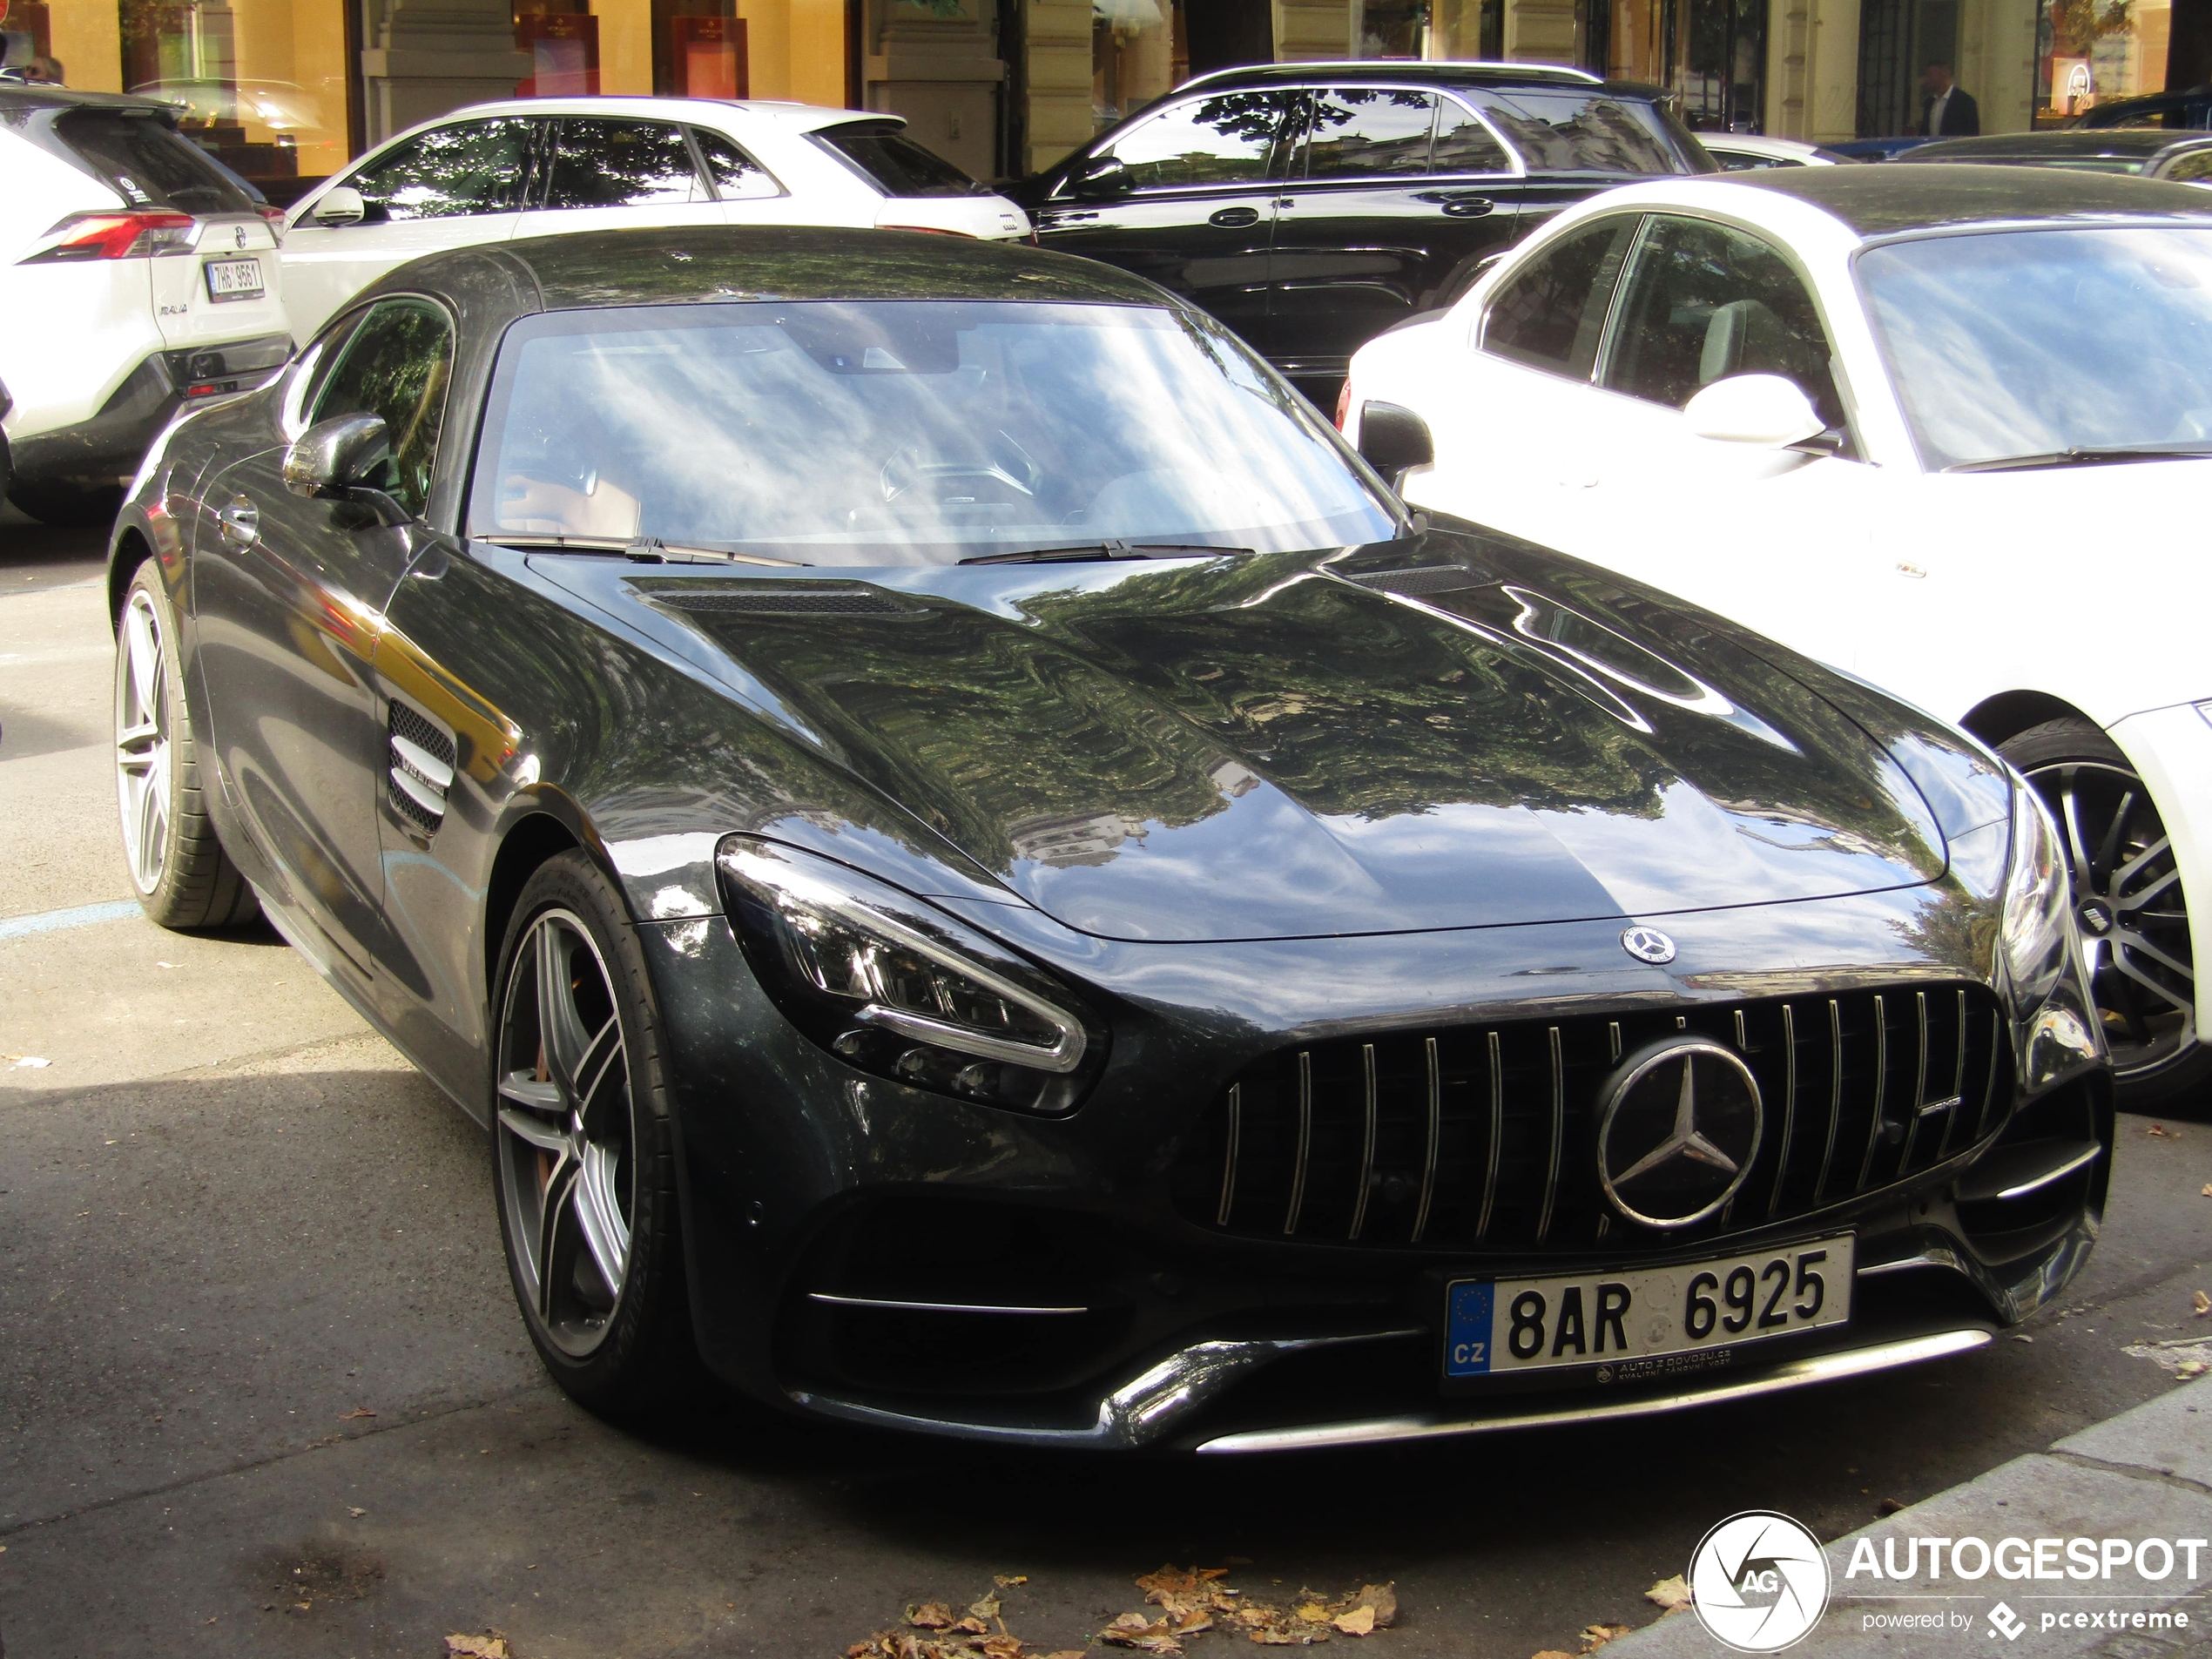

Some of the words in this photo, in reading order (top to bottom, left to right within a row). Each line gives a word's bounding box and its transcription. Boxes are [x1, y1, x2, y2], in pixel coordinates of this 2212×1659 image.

[214, 266, 233, 291] 7H6
[236, 264, 258, 288] 9561
[1508, 1282, 1632, 1359] 8AR
[1684, 1250, 1828, 1340] 6925
[1453, 1342, 1485, 1365] CZ
[1620, 1360, 1653, 1372] AUTO
